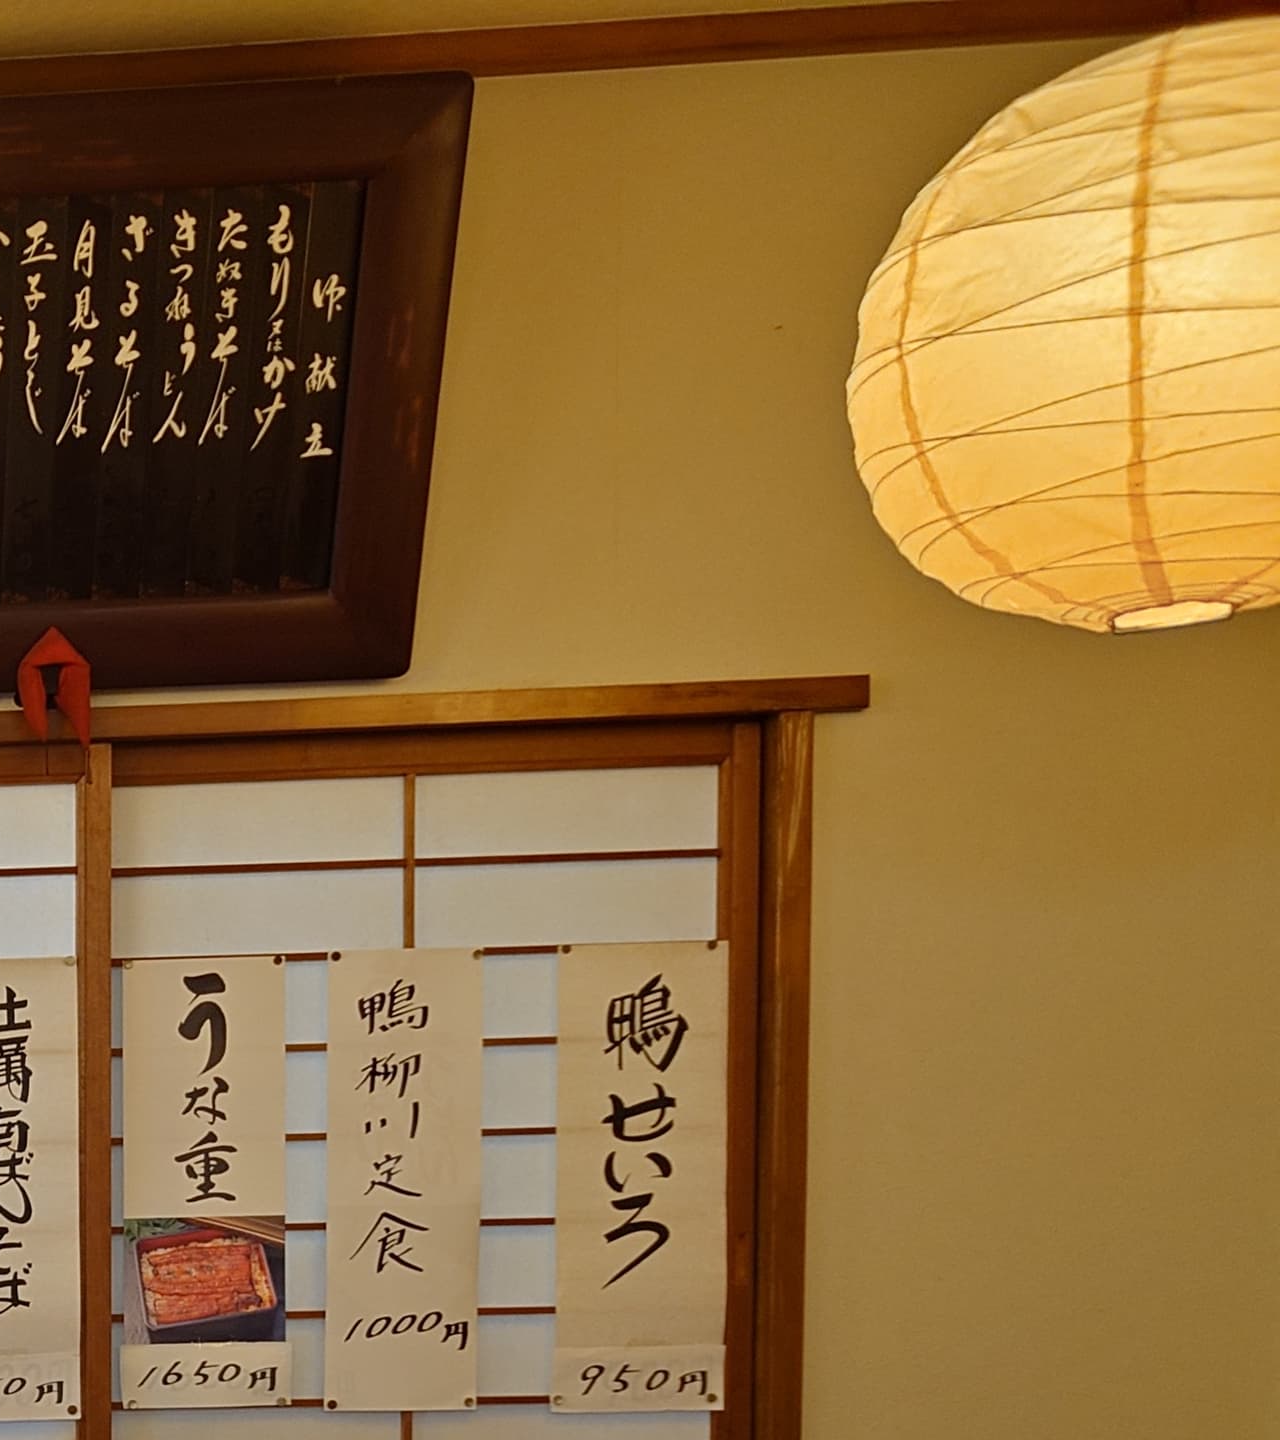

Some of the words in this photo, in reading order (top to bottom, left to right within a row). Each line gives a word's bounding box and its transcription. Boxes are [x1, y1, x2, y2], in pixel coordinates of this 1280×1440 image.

[174, 971, 238, 1204] うな重
[350, 978, 430, 1275] 鴨柳川定食
[602, 973, 690, 1291] 鴨せいろ
[138, 1361, 279, 1393] 1650円
[344, 1311, 471, 1352] 1000円
[579, 1363, 710, 1397] 950円
